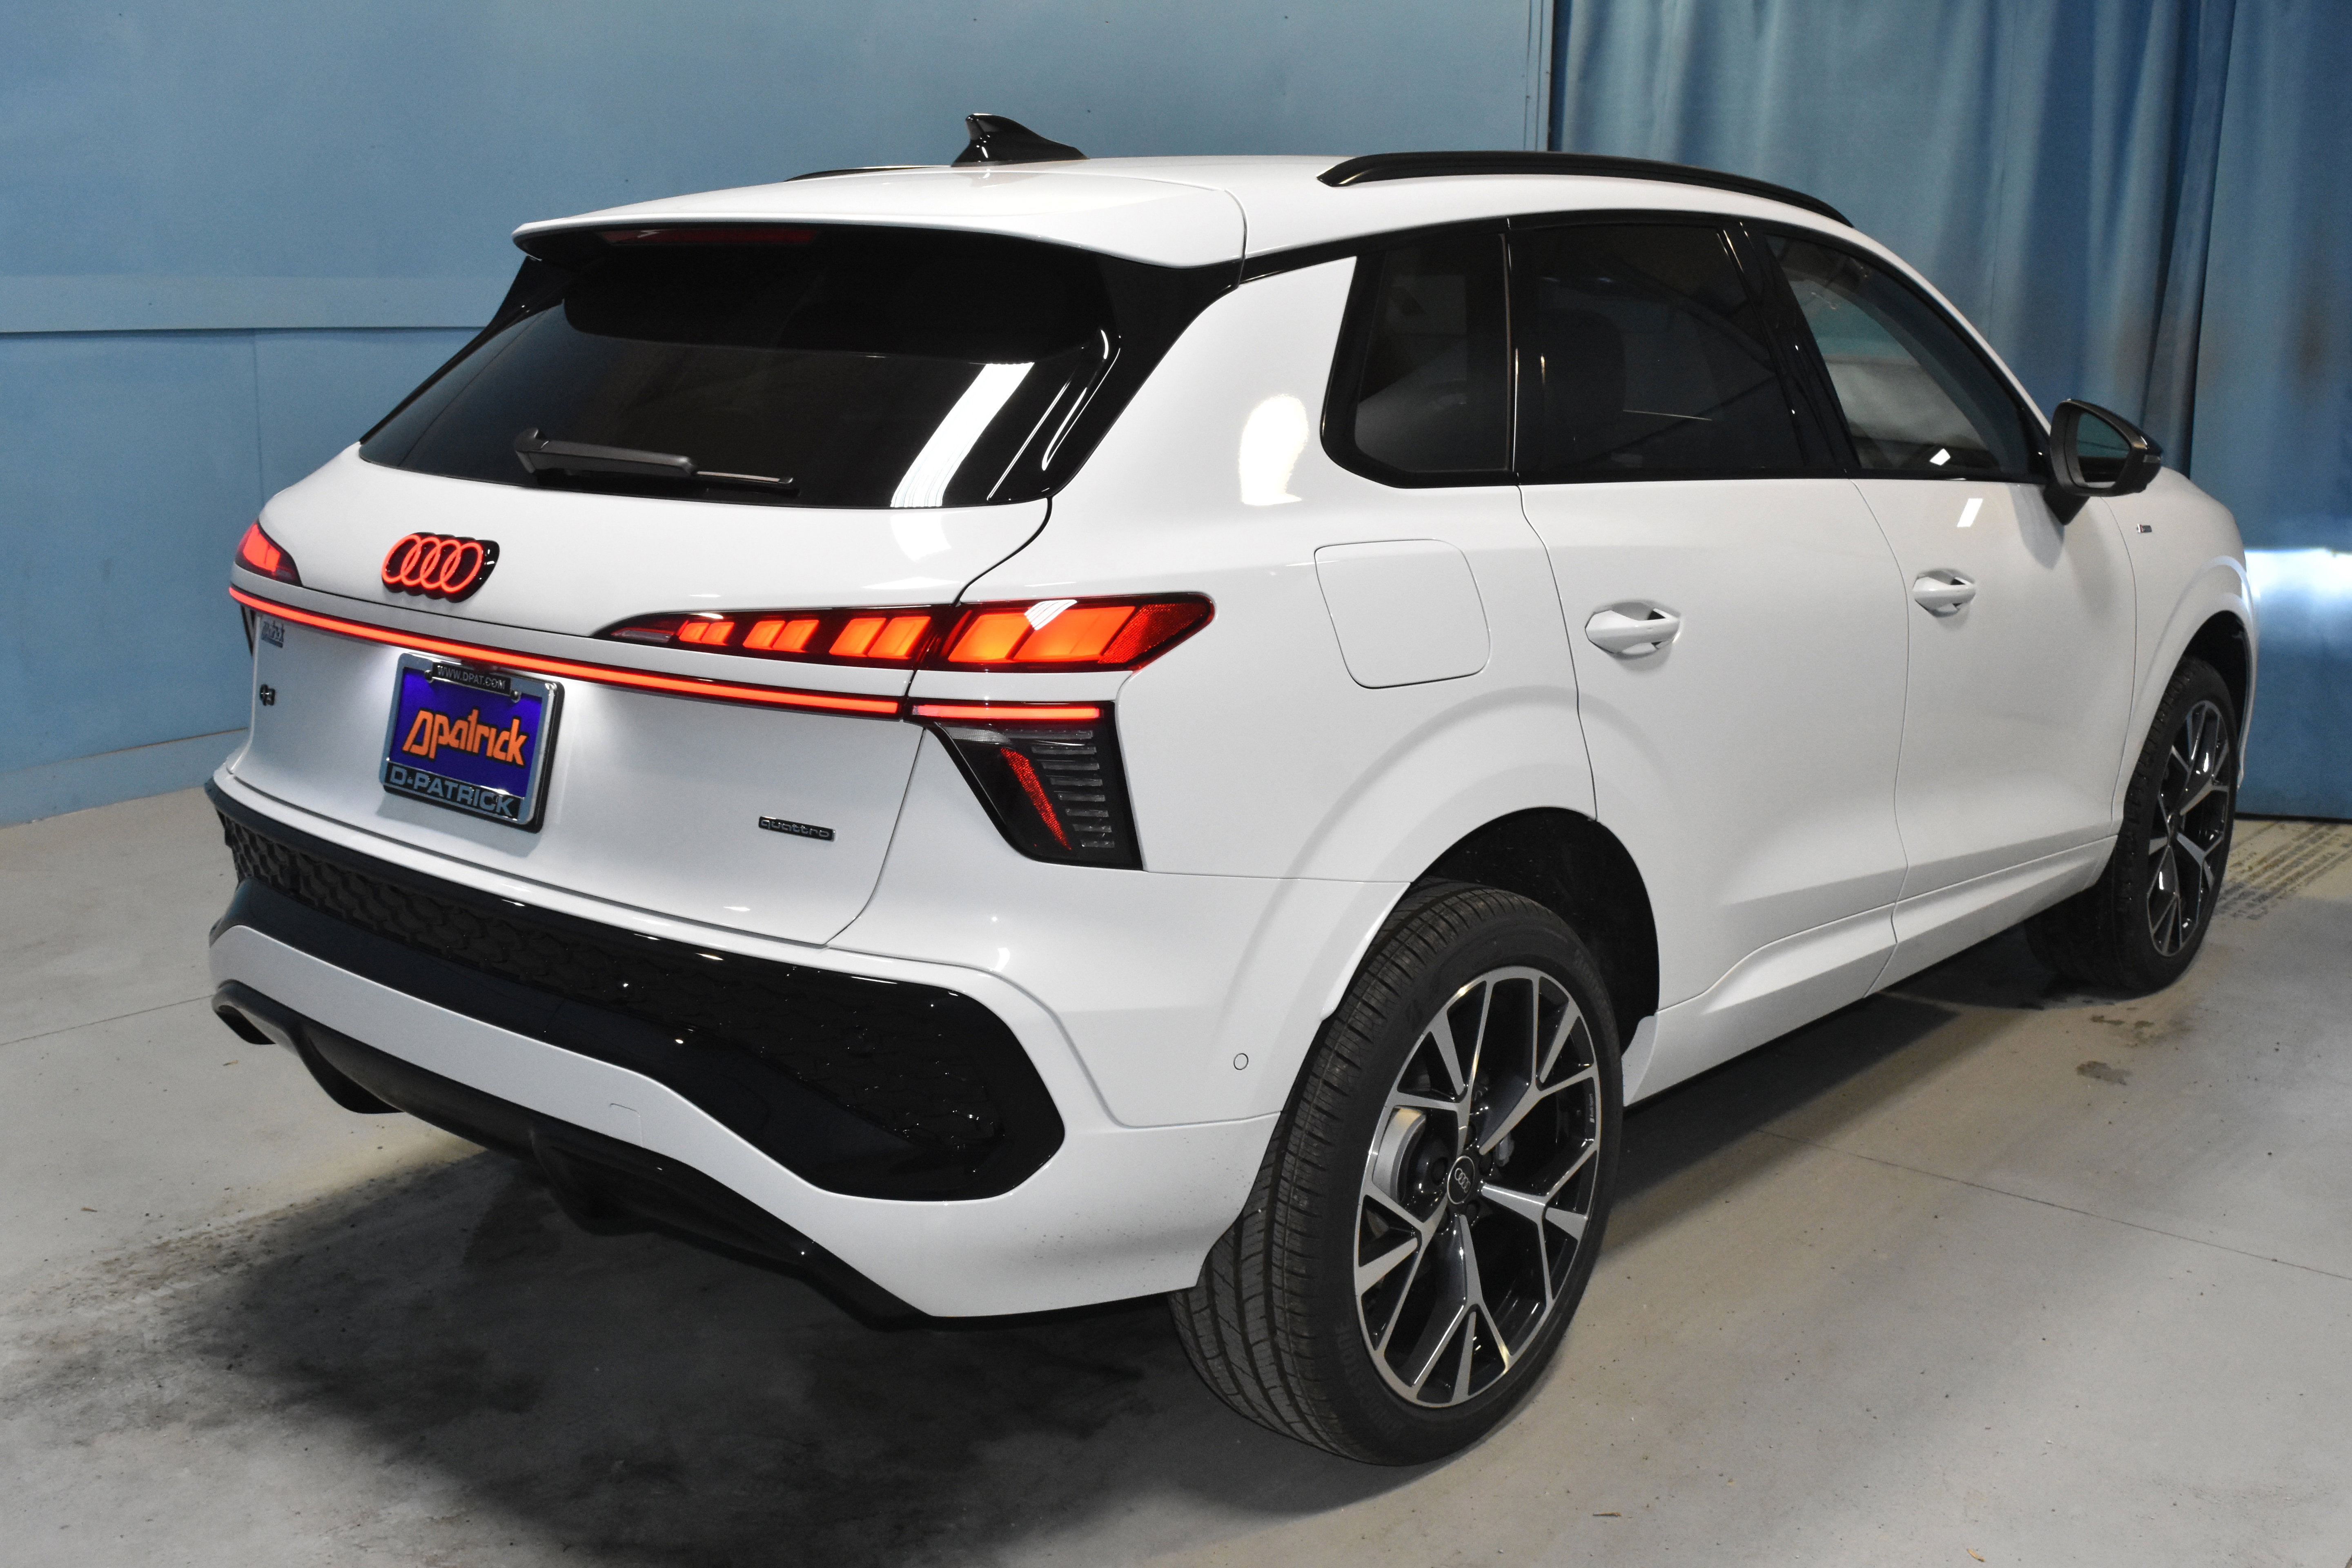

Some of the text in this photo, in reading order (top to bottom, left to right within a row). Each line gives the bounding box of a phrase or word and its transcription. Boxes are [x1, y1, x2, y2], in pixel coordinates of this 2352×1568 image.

[437, 665, 506, 690] WWW.DPAT.COM
[389, 766, 514, 817] D-PATRICK
[761, 819, 830, 837] quattro
